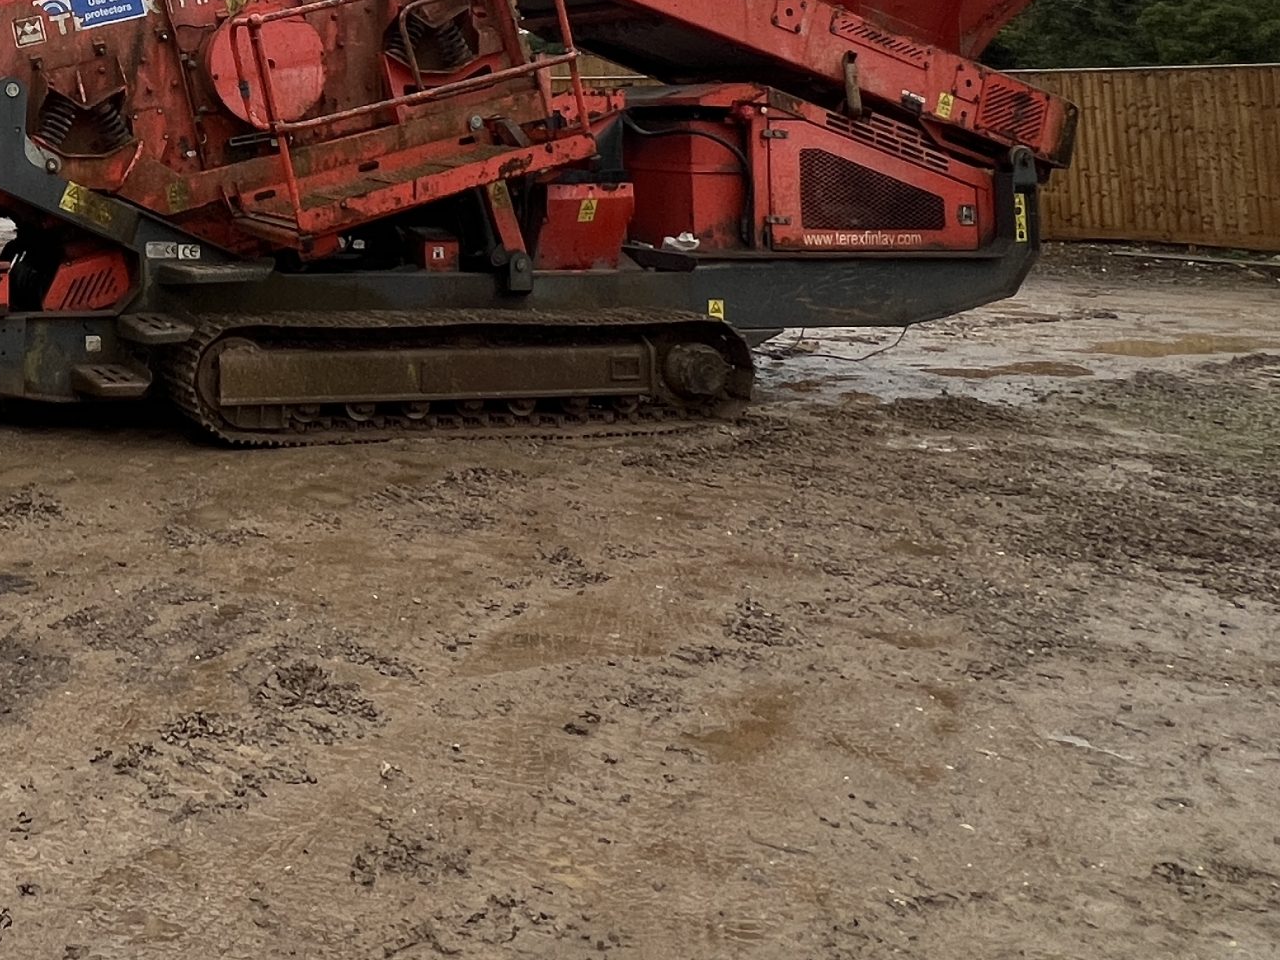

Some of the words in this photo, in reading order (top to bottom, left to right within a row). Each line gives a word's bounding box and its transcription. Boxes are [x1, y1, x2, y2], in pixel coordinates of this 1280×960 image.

[84, 2, 132, 22] protectors
[803, 230, 922, 248] www.terexfinlay.com
[182, 245, 199, 258] CE
